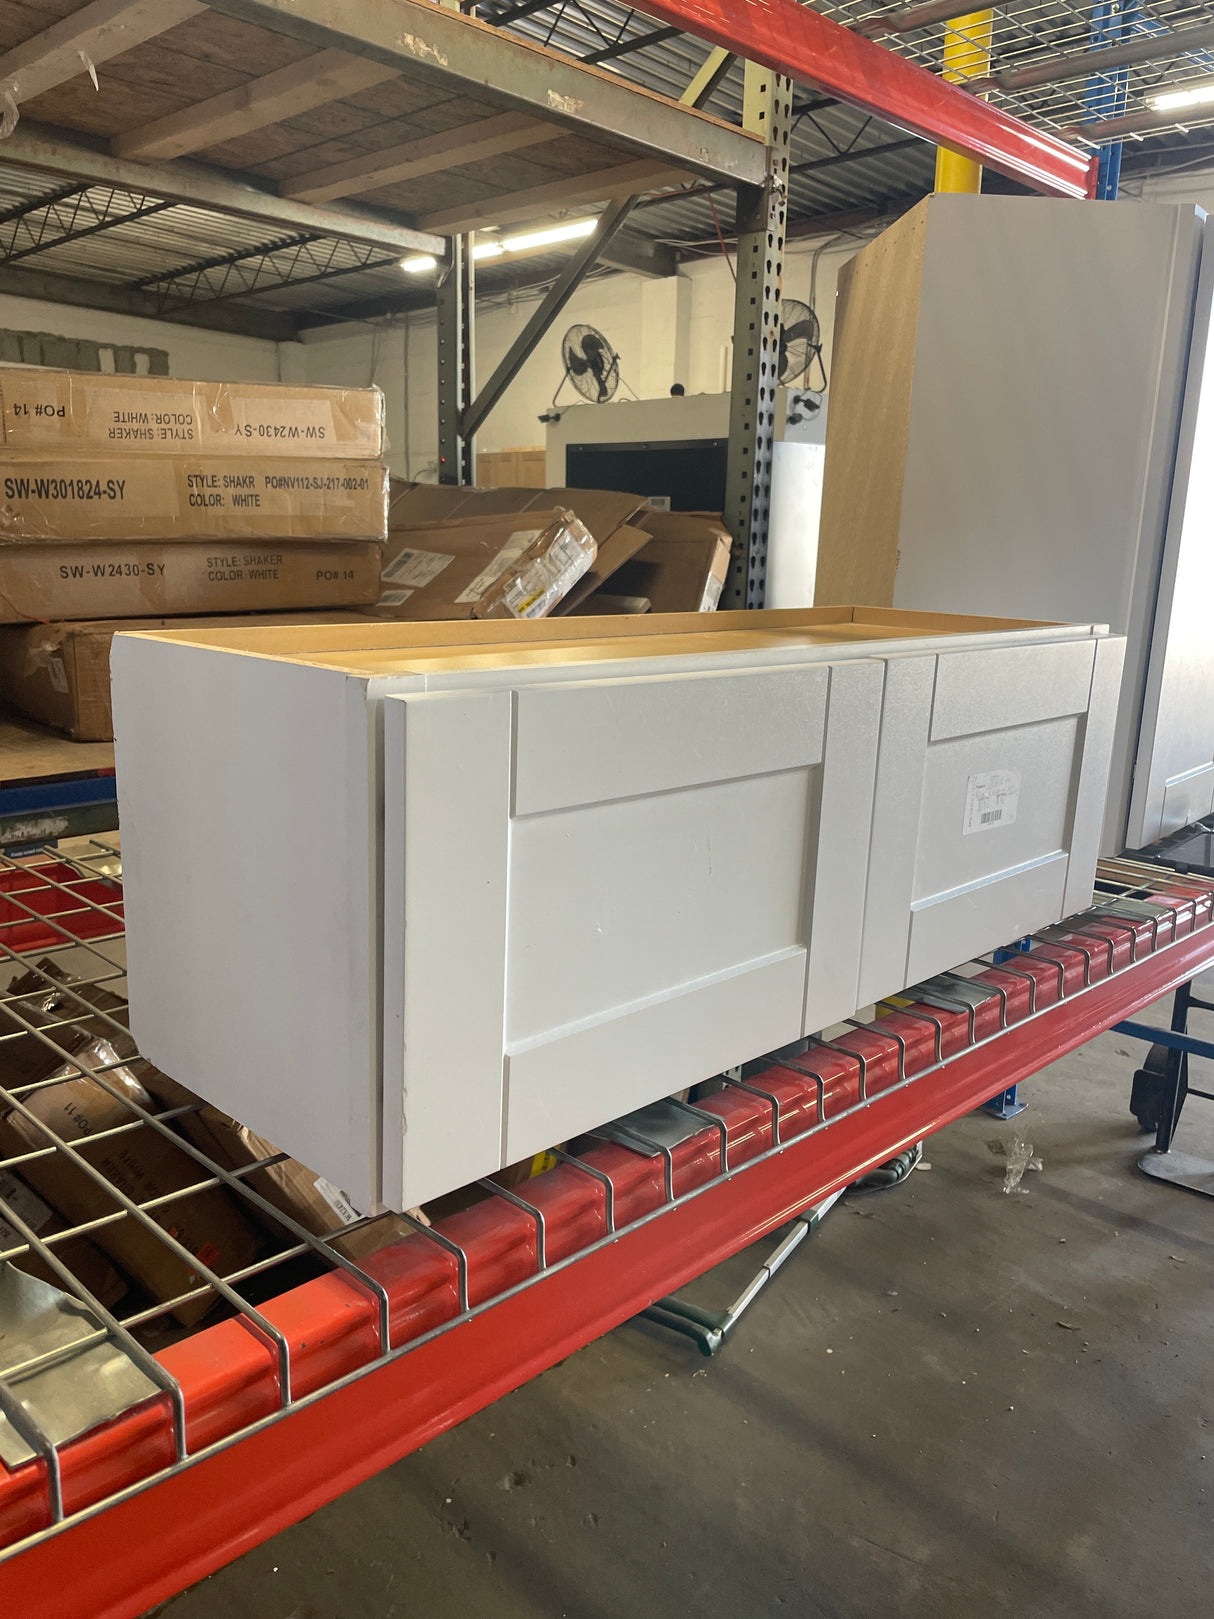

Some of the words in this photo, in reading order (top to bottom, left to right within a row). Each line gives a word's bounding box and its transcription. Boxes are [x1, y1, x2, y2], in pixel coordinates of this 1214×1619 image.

[13, 403, 30, 417] 14
[35, 404, 66, 418] PO#
[113, 411, 149, 424] WHITE
[151, 412, 193, 426] COLOR:
[108, 427, 154, 440] SHAKER
[157, 427, 194, 441] STYLE:
[234, 423, 326, 440] SW-W2430-SY
[187, 474, 221, 489] STYLE:
[223, 475, 256, 489] SHAKR
[4, 477, 126, 501] SW-W301824-SY
[188, 493, 225, 508] COLOR:
[231, 494, 261, 508] WHITE
[243, 554, 283, 568] SHAKER
[59, 562, 166, 580] SW-W2430-SY
[249, 569, 279, 582] WHITE
[316, 570, 338, 582] PO#
[343, 570, 354, 581] 14
